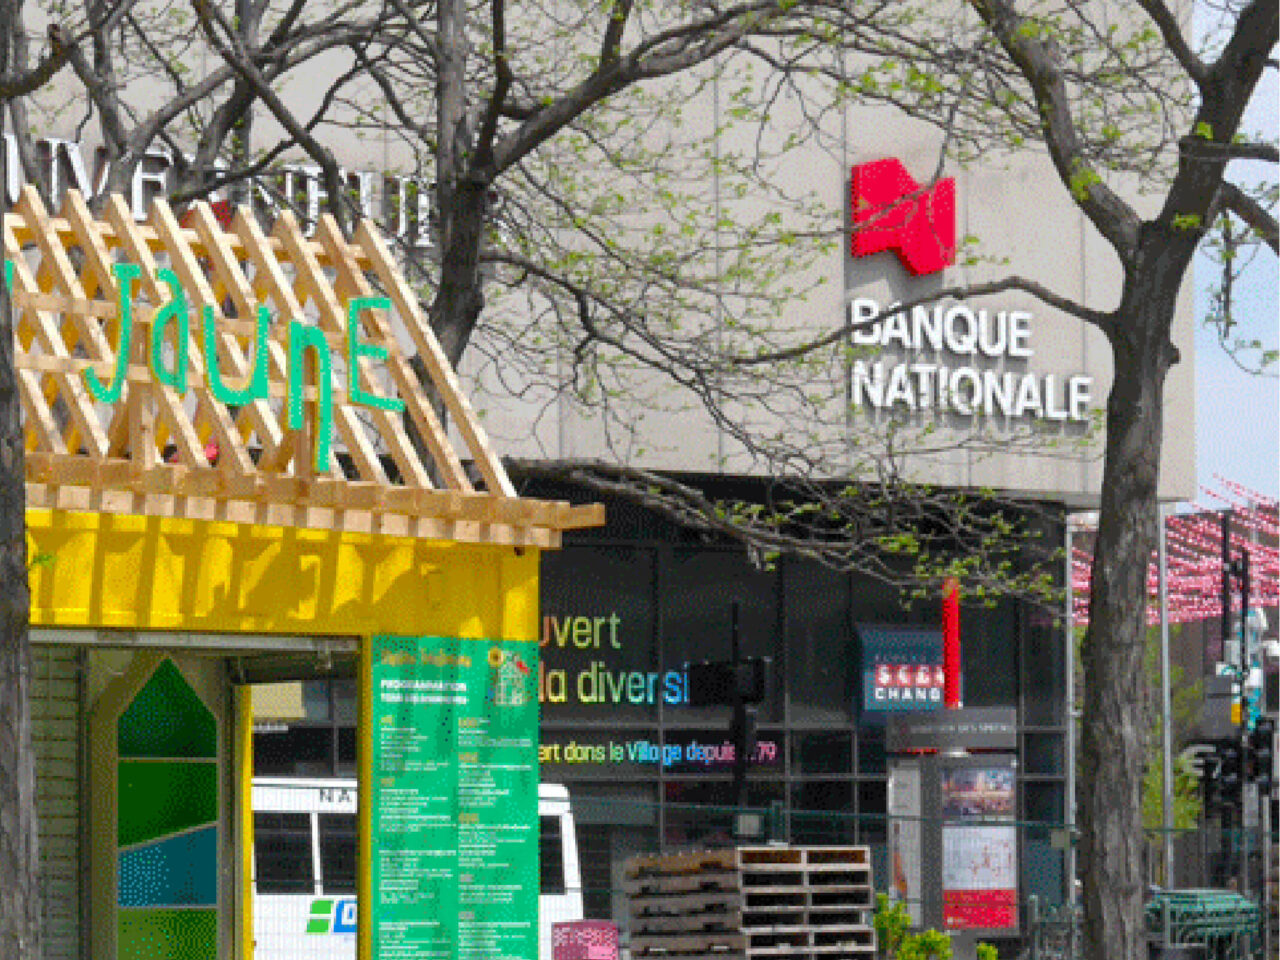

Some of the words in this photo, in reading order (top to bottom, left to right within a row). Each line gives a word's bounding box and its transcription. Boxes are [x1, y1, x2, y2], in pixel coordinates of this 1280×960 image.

[850, 298, 1035, 358] BANQUE
[850, 360, 1094, 422] NATIONALE
[625, 740, 683, 767] Village
